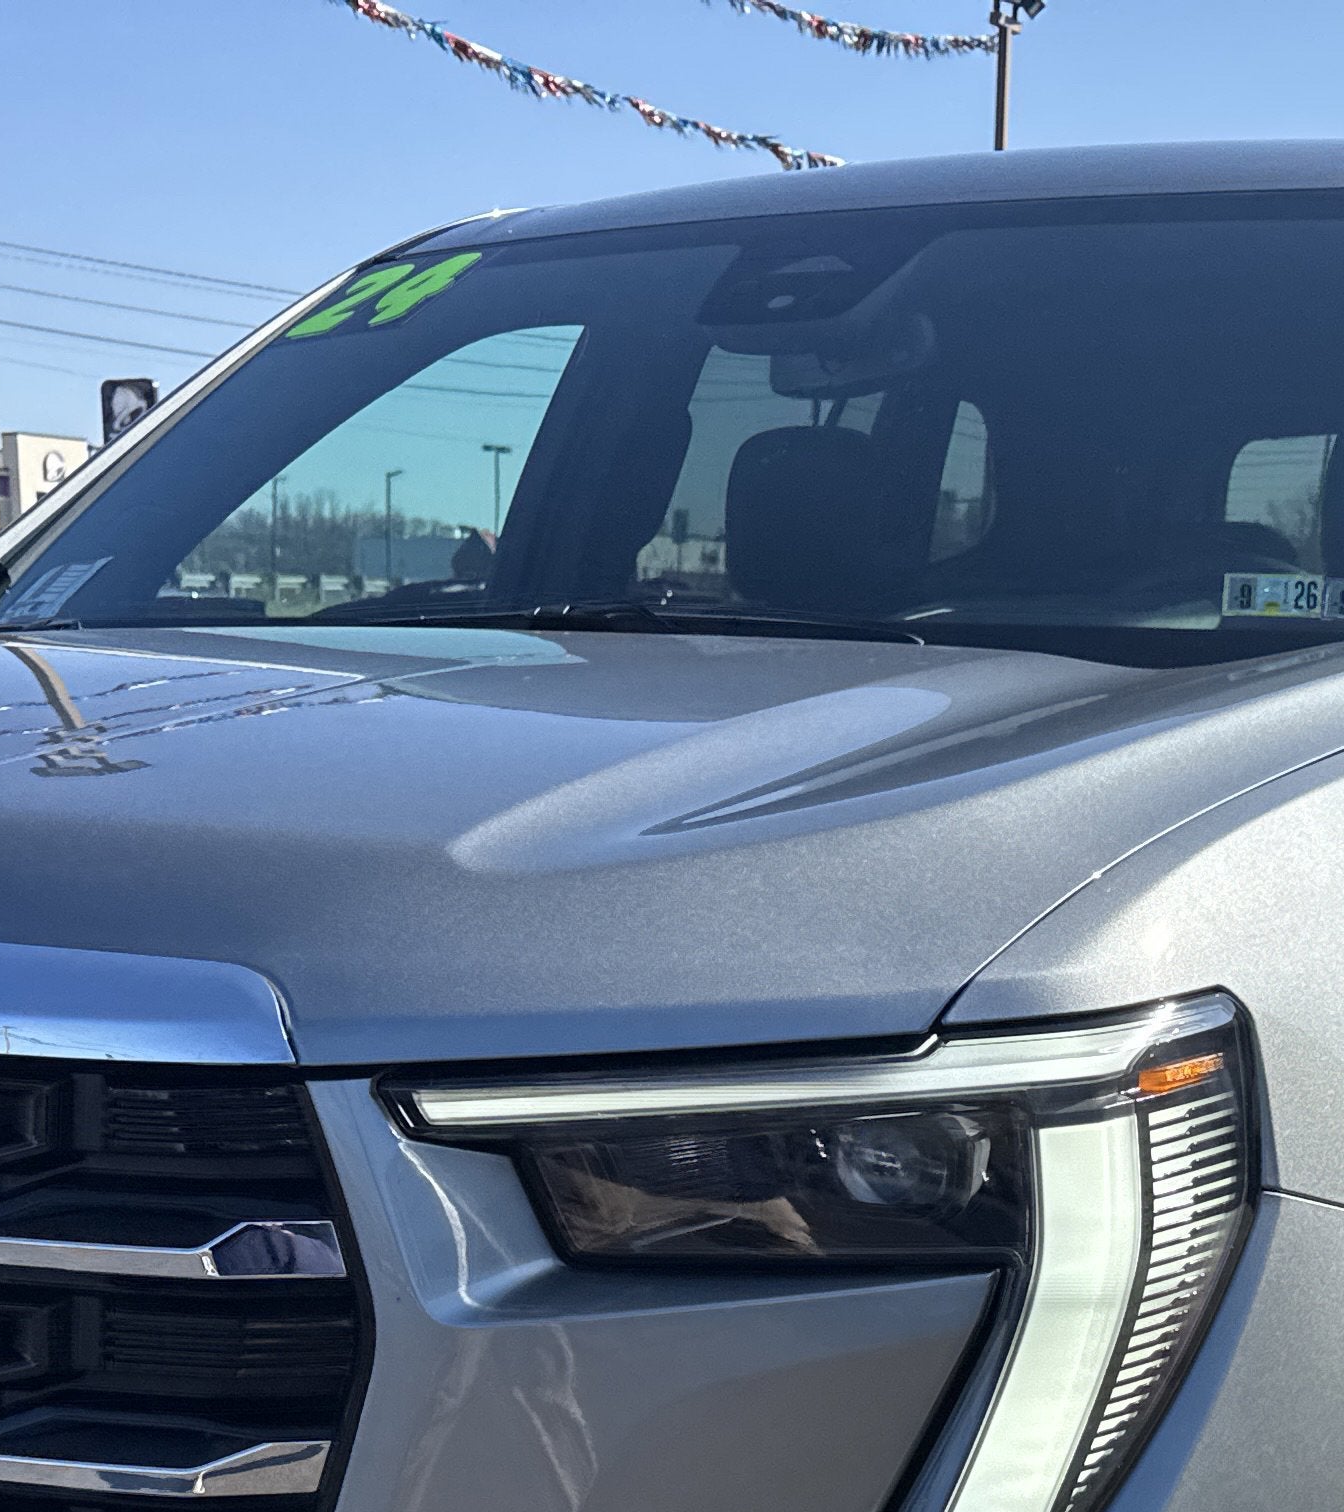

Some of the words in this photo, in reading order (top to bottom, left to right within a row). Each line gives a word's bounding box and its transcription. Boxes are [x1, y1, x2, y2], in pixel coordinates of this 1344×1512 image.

[286, 252, 483, 339] 24
[1240, 584, 1253, 609] 9
[1293, 580, 1318, 610] 26
